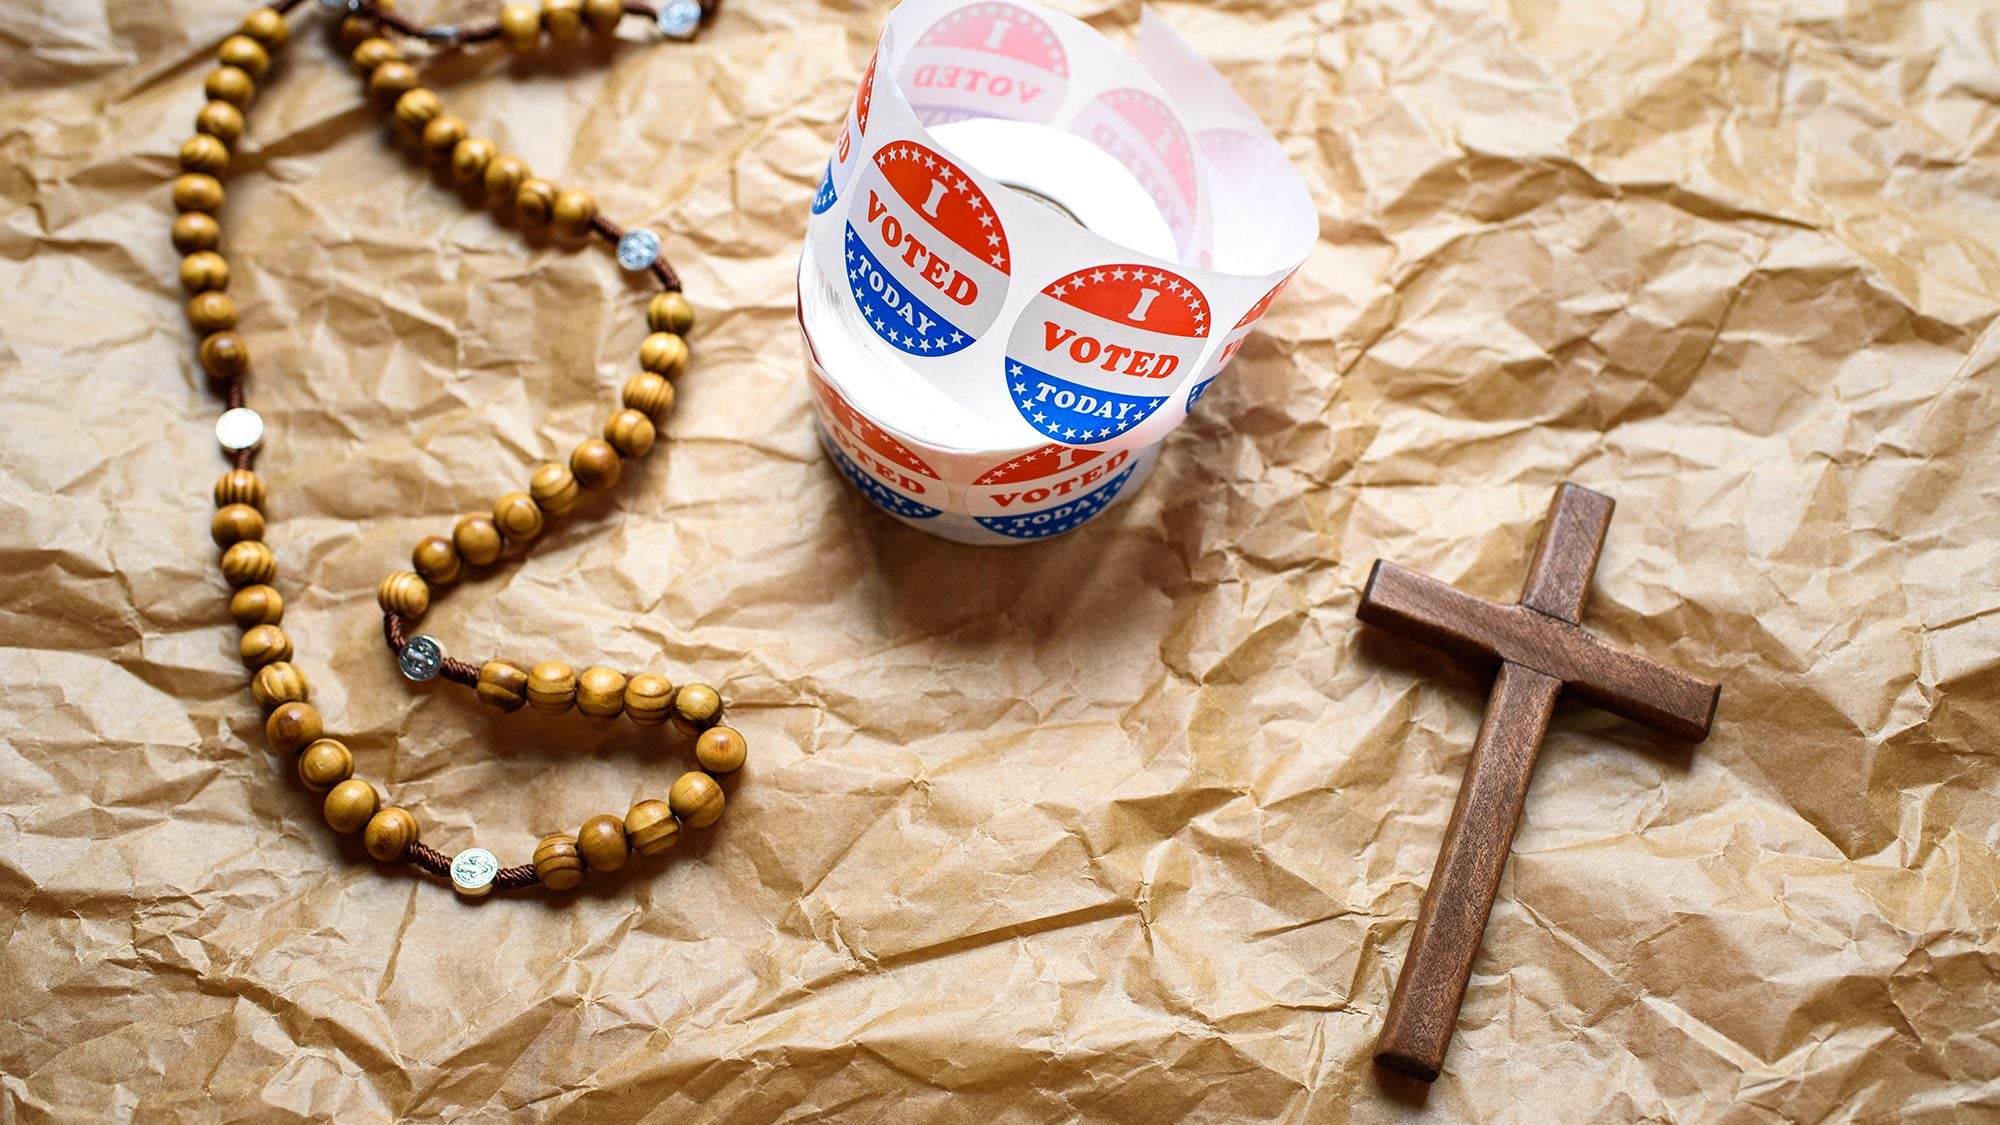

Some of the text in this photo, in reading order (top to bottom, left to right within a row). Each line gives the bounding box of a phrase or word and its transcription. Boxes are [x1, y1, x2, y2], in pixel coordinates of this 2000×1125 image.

[921, 178, 949, 219] I
[867, 189, 979, 306] VOTED
[858, 255, 936, 336] TODAY
[1127, 288, 1160, 321] I
[1044, 321, 1180, 379] VOTED
[1035, 382, 1136, 419] TODAY
[848, 414, 866, 440] I
[990, 449, 1129, 507] VOTED
[1057, 448, 1076, 470] I
[1012, 487, 1109, 528] TODAY
